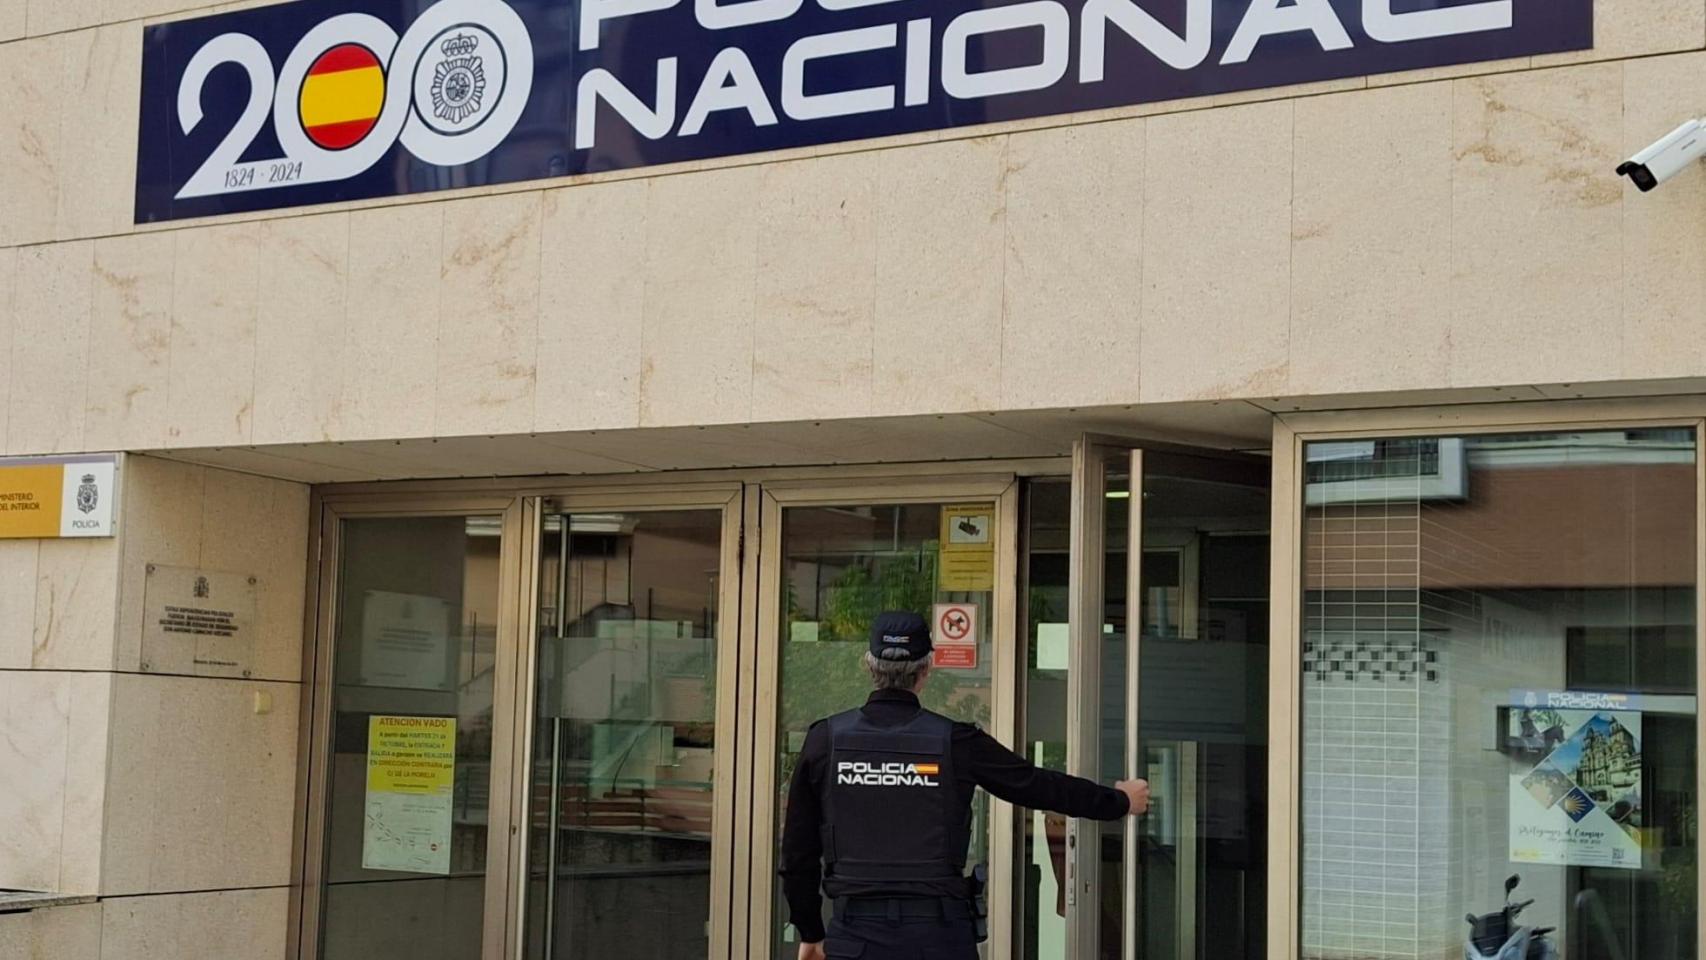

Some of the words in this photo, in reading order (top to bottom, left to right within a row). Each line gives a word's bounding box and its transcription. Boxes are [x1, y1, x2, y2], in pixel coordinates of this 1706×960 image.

[224, 167, 255, 188] 1824
[269, 161, 303, 182] 2024
[1548, 692, 1609, 701] POLICIA
[1548, 700, 1627, 709] NACIONAL
[423, 719, 448, 728] VADO
[838, 762, 917, 774] POLICIA
[838, 774, 939, 786] NACIONAL
